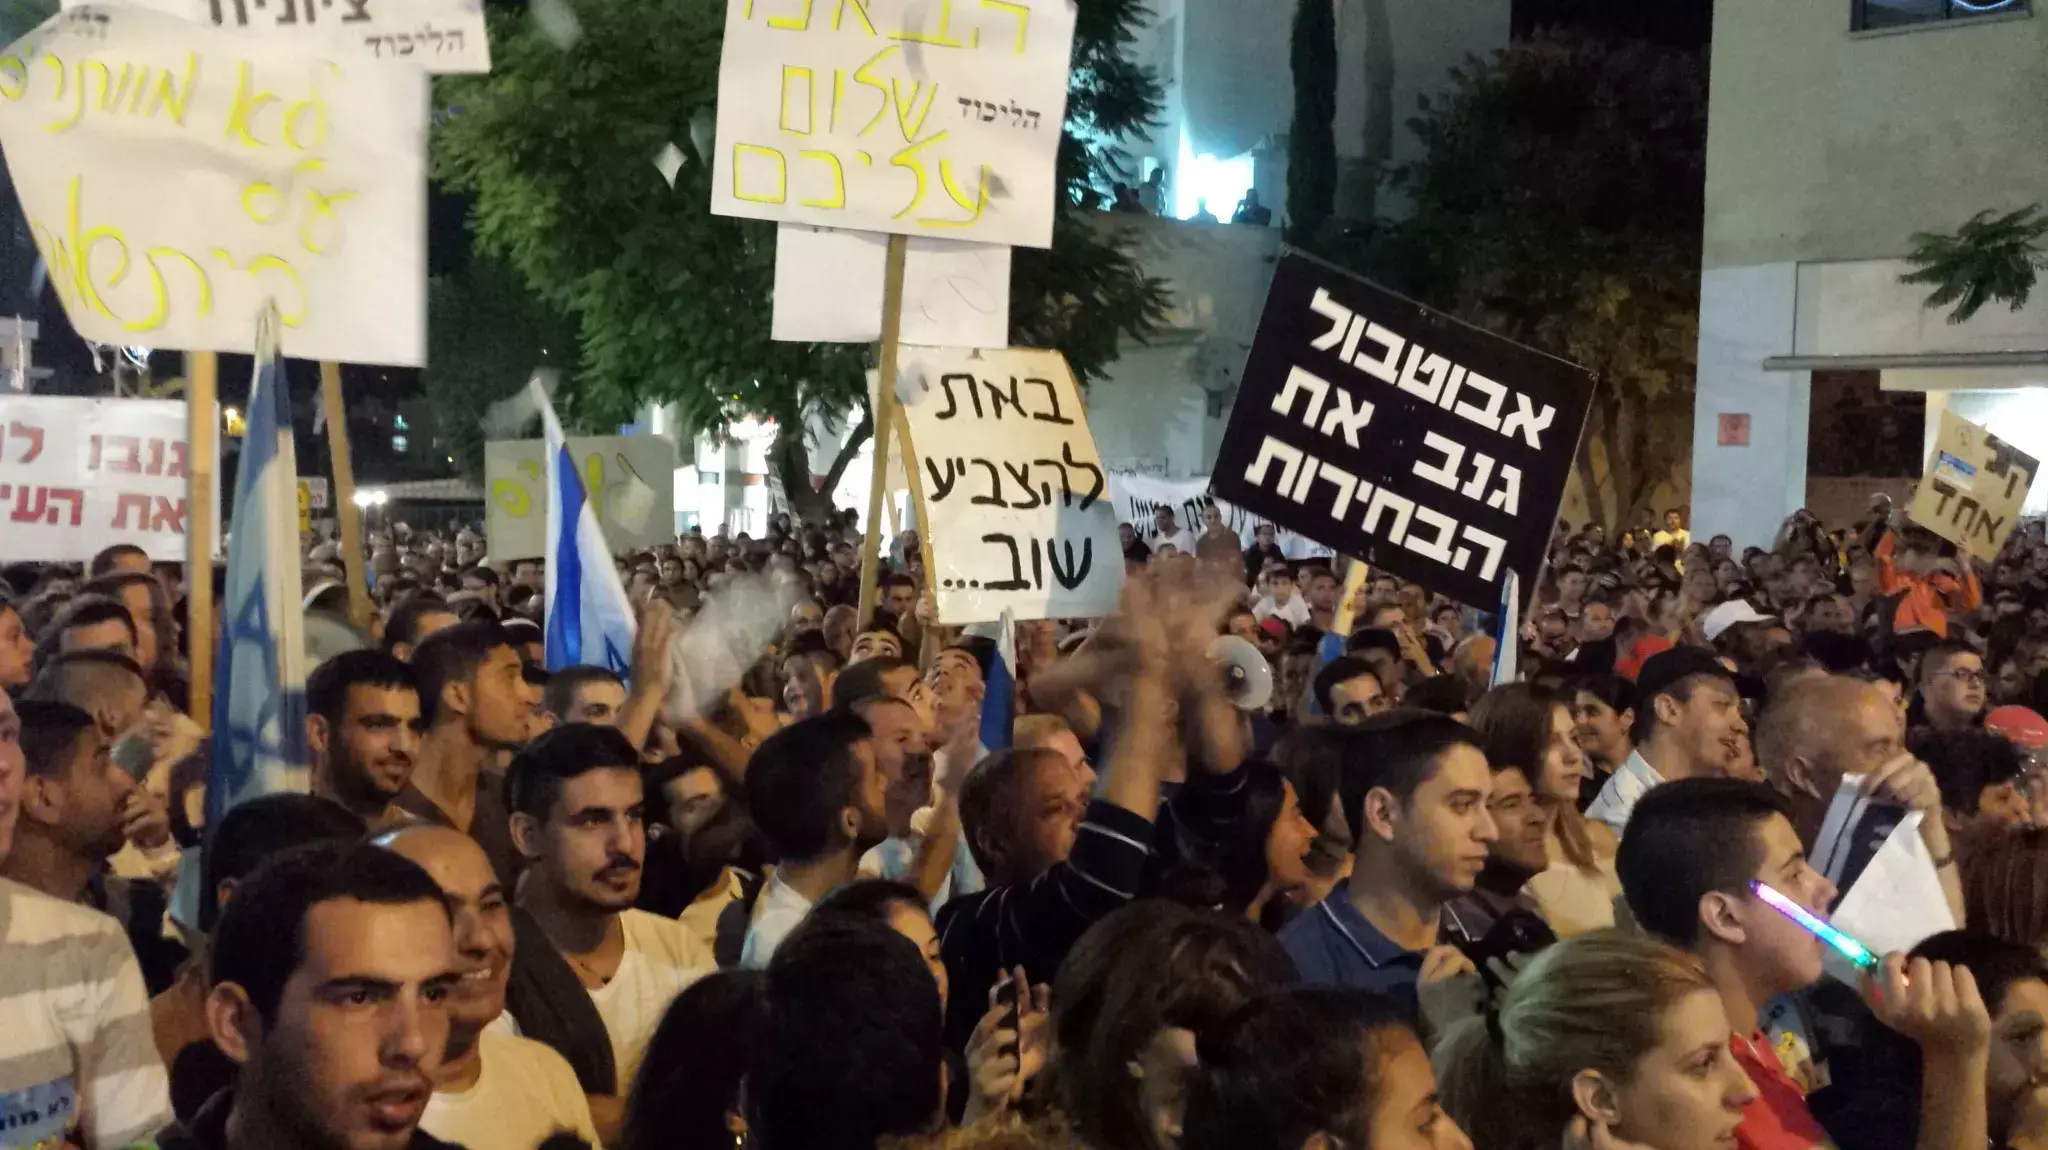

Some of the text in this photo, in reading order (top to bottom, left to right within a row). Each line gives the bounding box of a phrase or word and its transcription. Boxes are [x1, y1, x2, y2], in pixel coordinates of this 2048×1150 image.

[364, 23, 464, 58] הליכוד
[779, 45, 940, 143] שלום
[957, 97, 1042, 131] הליכוד
[732, 130, 993, 228] עליכם
[1310, 287, 1556, 450] אבוטבול
[0, 420, 188, 479] גנבו ל
[1271, 364, 1525, 517] גנב את
[925, 441, 1105, 511] להצביע
[1244, 434, 1508, 583] הבחירות
[111, 492, 188, 534] את
[1932, 477, 2005, 545] אחד
[943, 533, 1093, 591] שוב...
